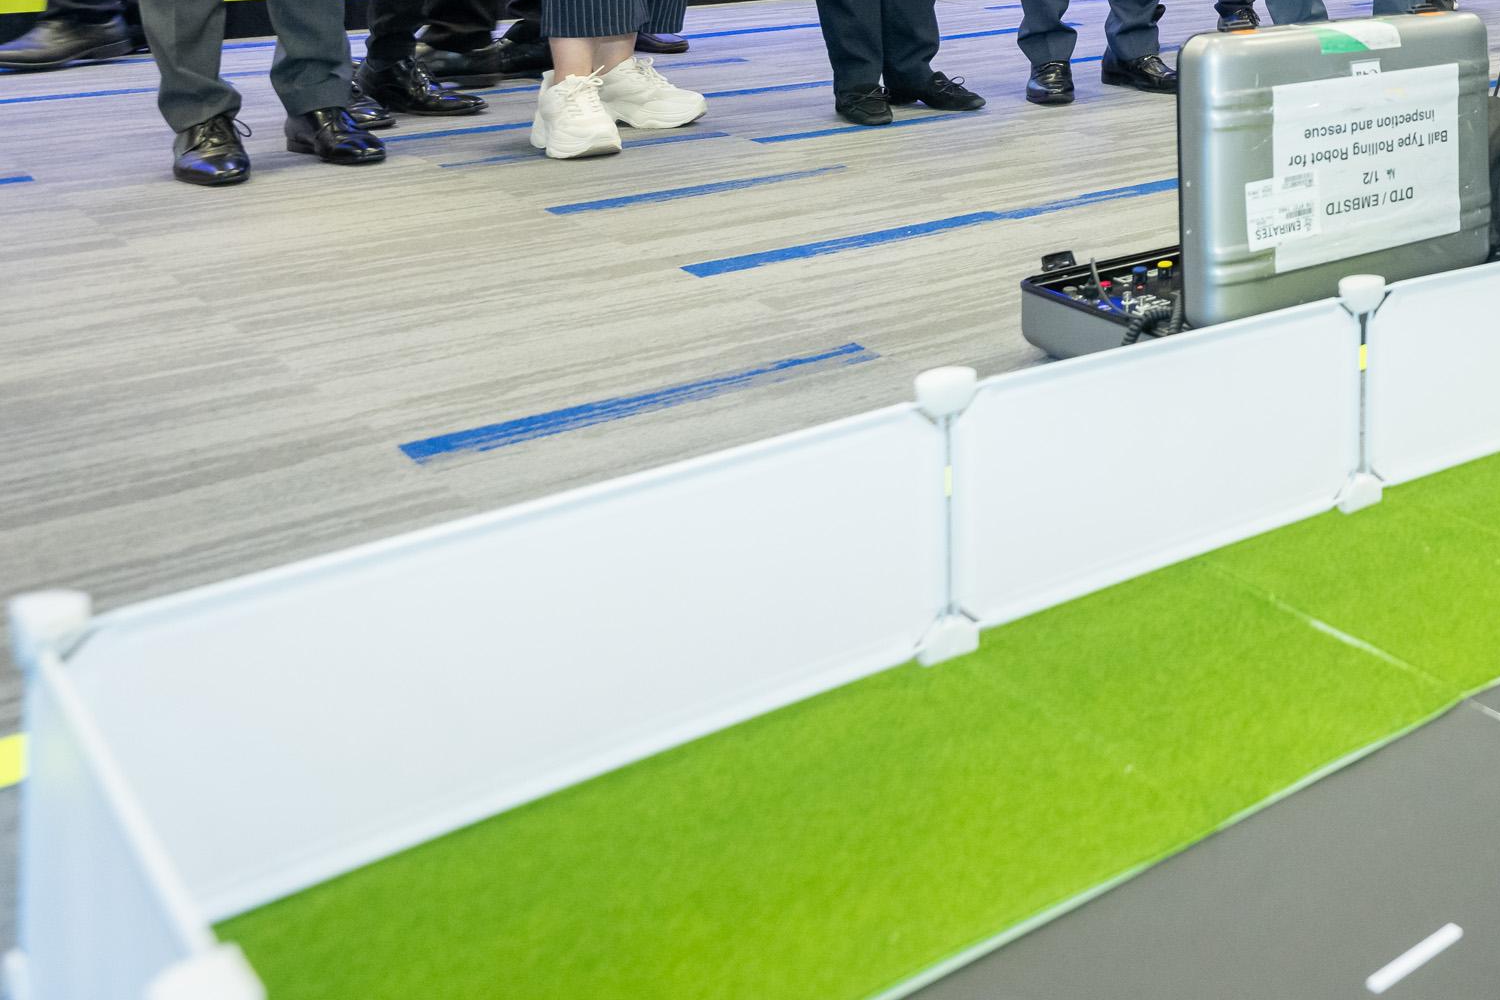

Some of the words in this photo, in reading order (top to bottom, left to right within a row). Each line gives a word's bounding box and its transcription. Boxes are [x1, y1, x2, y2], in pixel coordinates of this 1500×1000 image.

[1351, 119, 1374, 134] and
[1377, 109, 1435, 129] inspection
[1304, 124, 1347, 139] rescue
[1428, 130, 1448, 144] Ball
[1353, 140, 1394, 156] Rolling
[1398, 135, 1425, 149] Type
[1288, 155, 1307, 167] for
[1312, 147, 1349, 161] Robot
[1390, 187, 1413, 201] DTD
[1326, 192, 1380, 216] EMBSTD
[1255, 220, 1302, 239] EMIRATES
